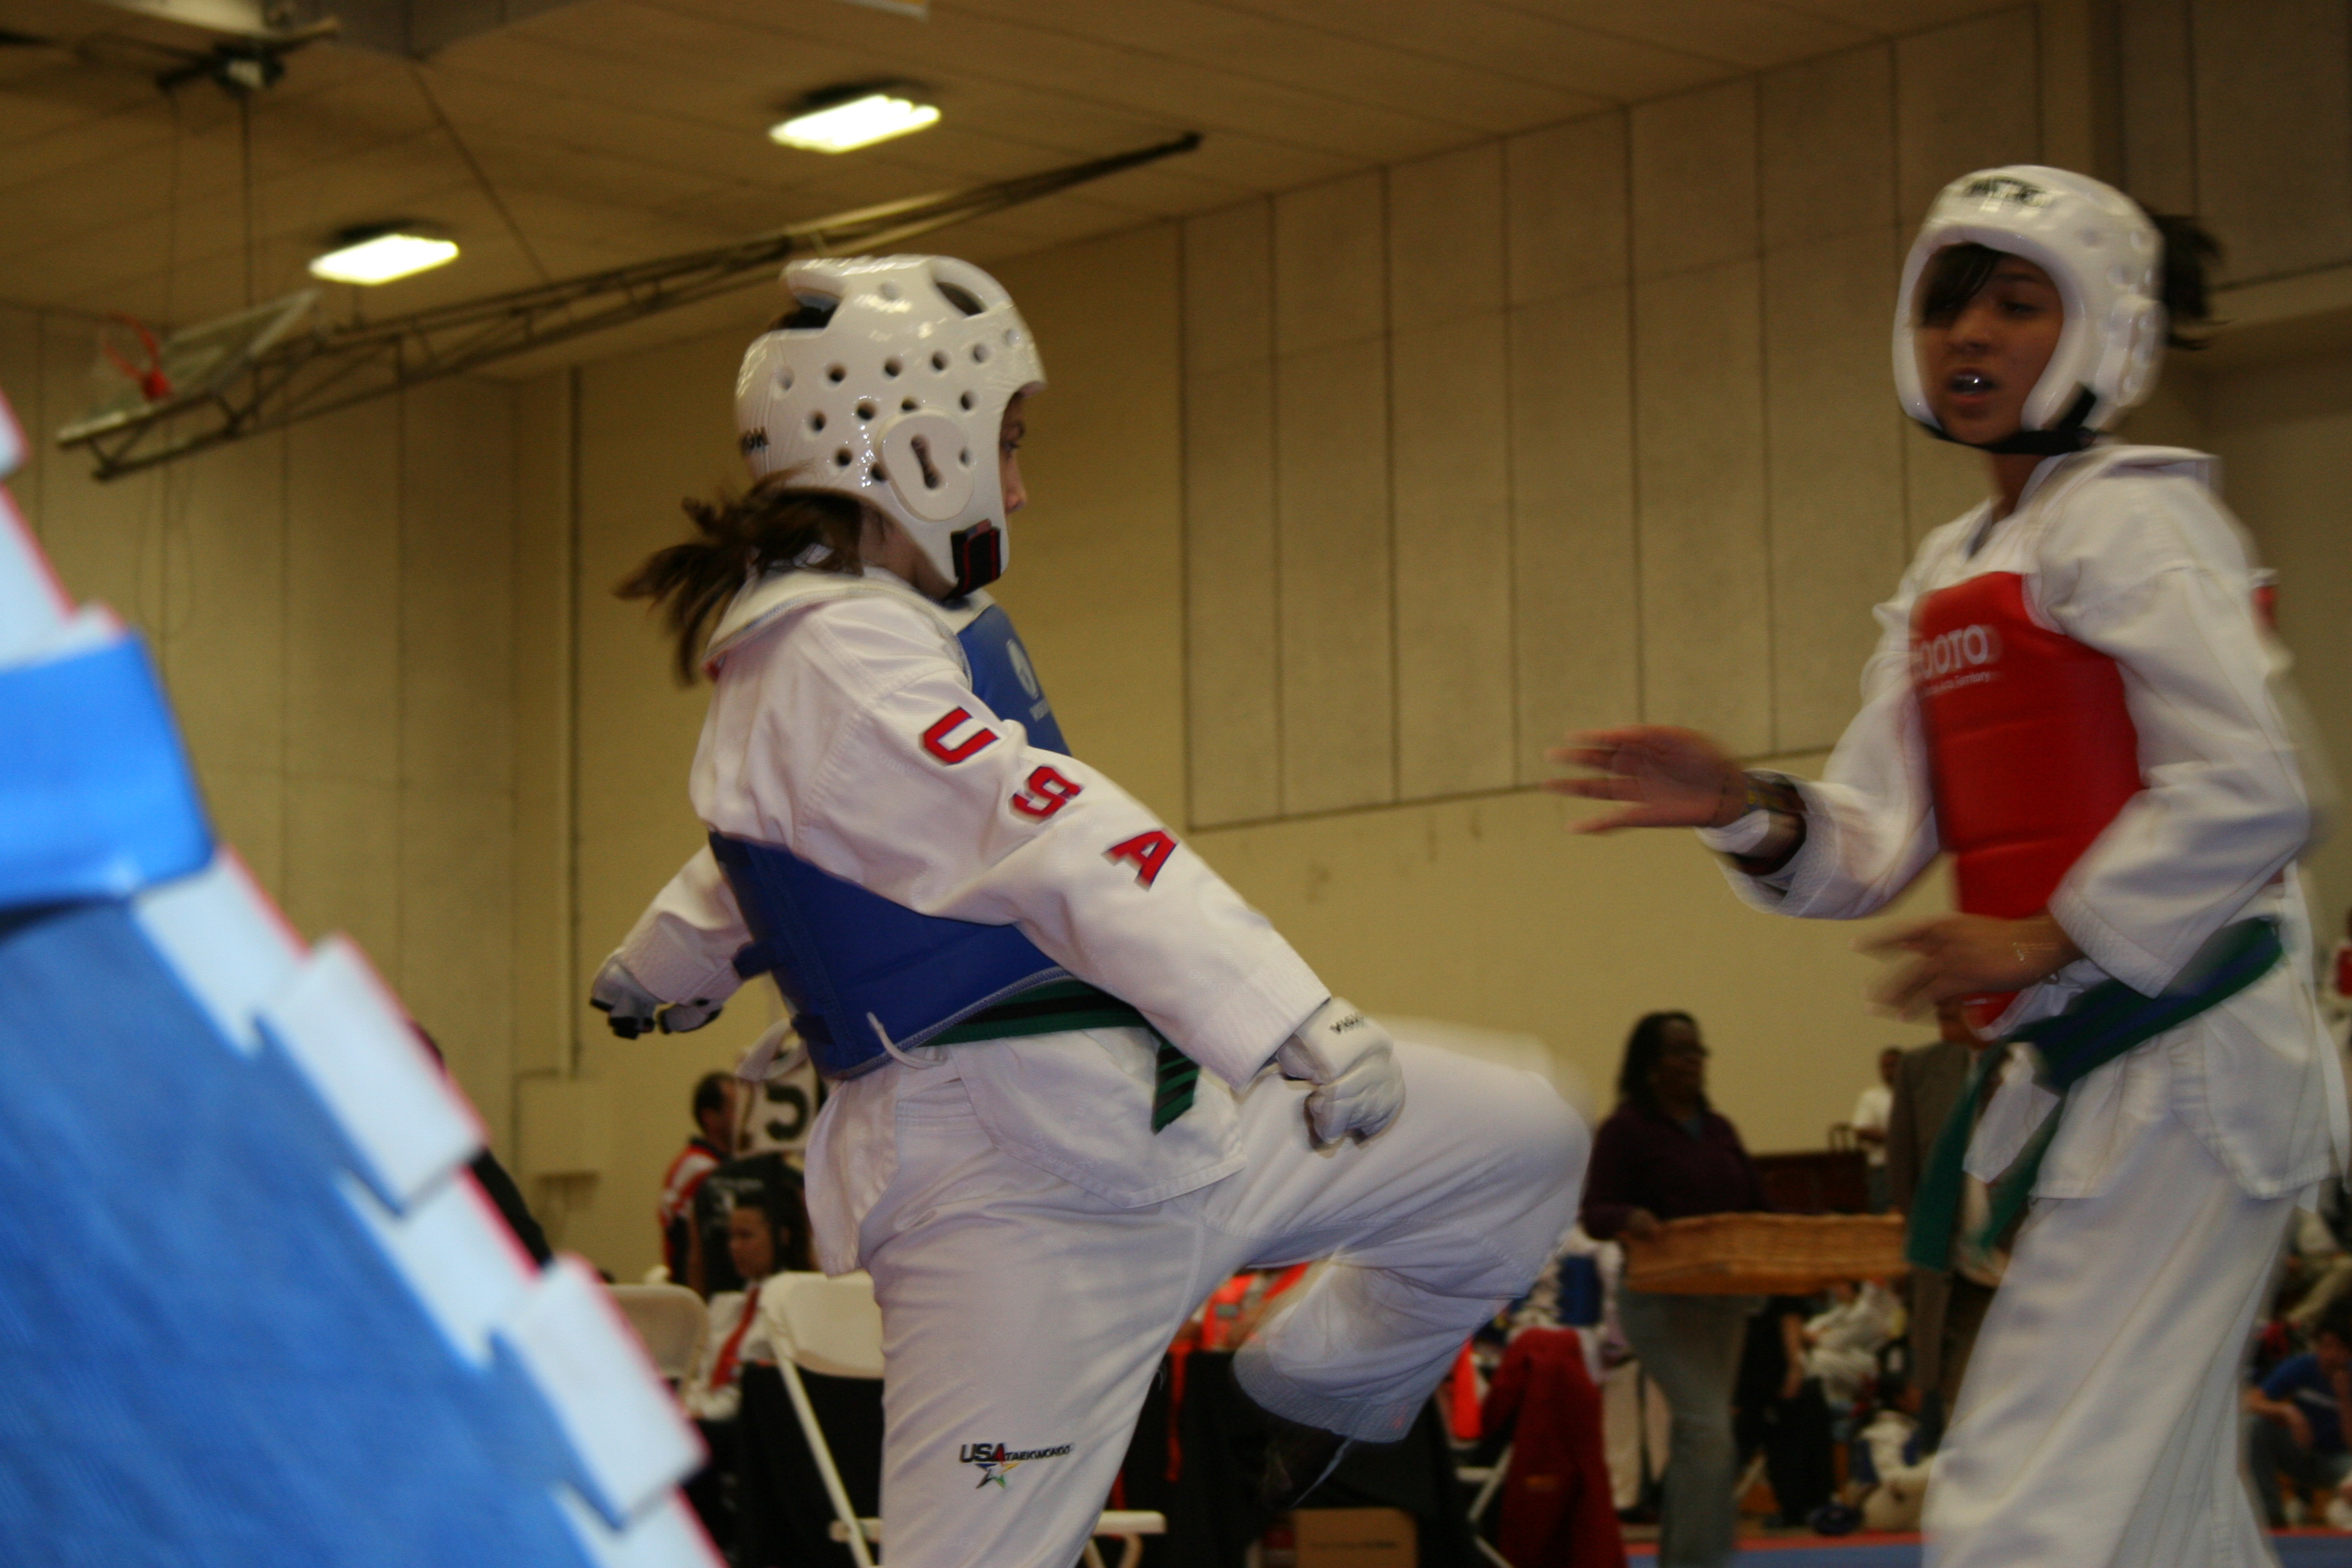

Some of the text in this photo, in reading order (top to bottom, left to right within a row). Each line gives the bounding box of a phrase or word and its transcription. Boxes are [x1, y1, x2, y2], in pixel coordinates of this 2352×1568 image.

[1916, 624, 1991, 679] OOTO
[960, 1442, 1072, 1463] USA TAEKWONDO
